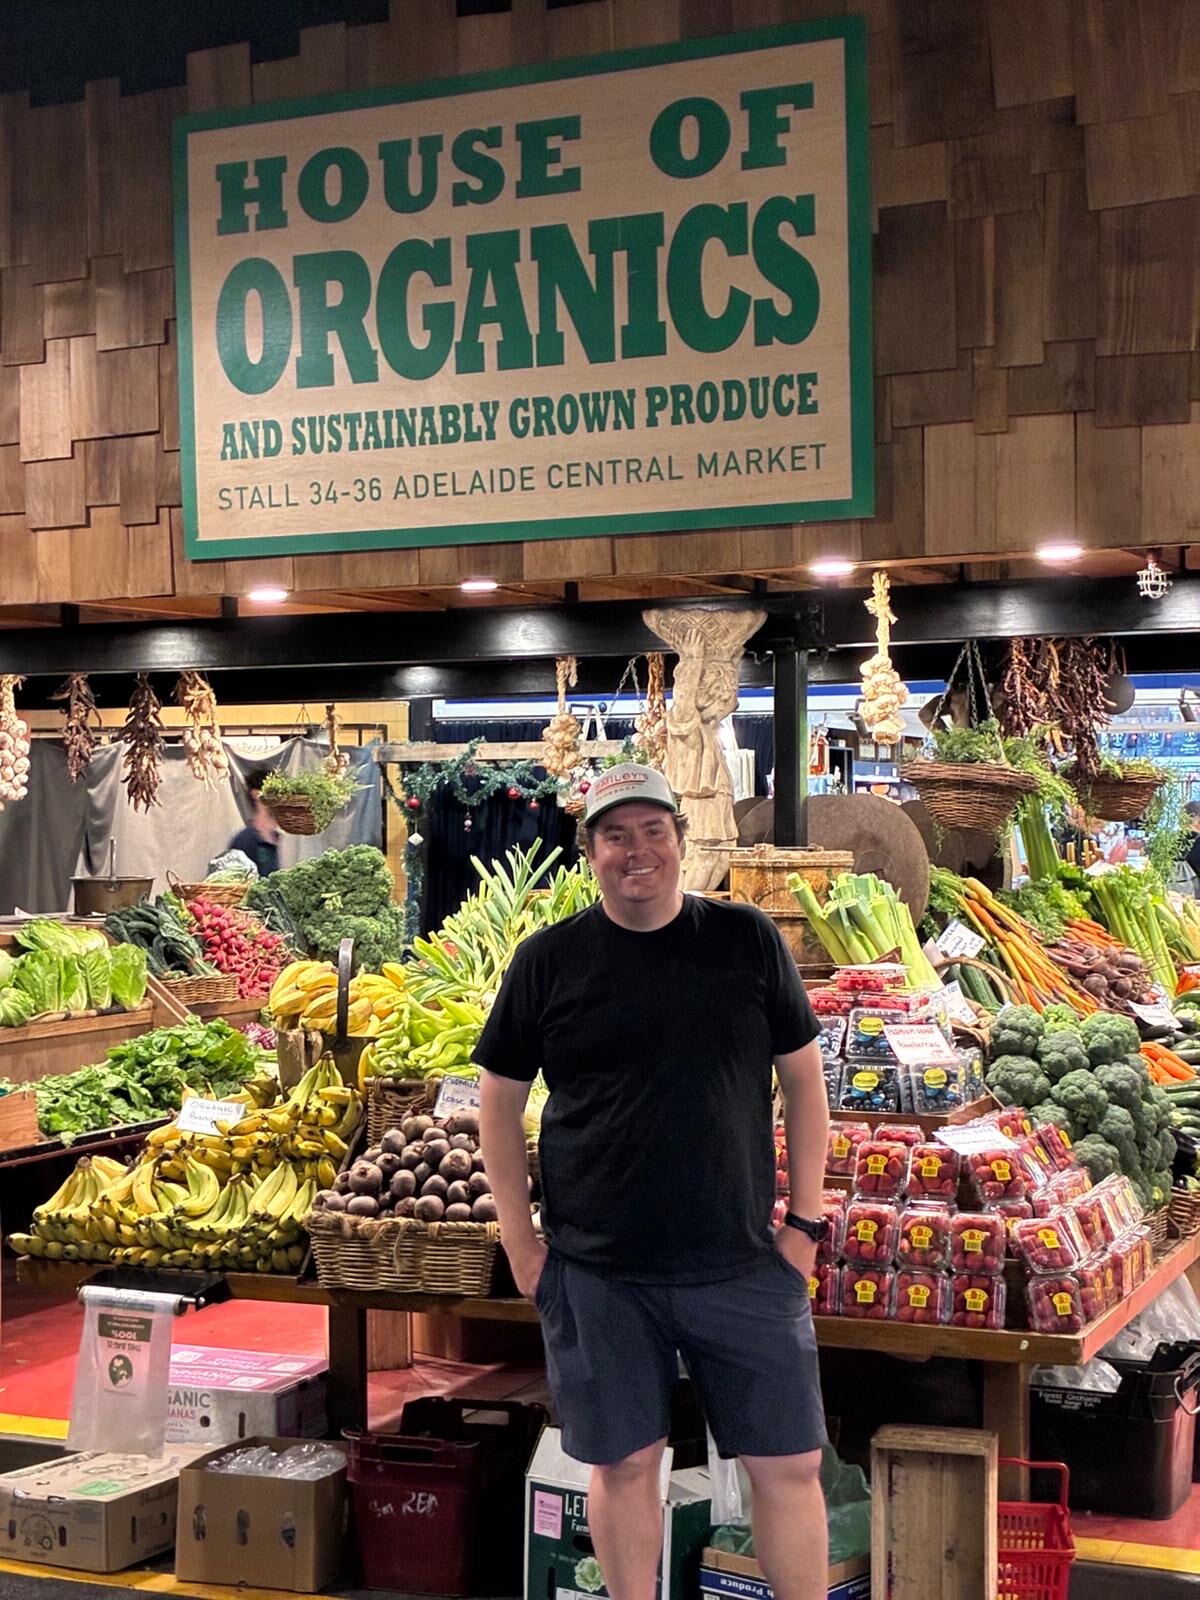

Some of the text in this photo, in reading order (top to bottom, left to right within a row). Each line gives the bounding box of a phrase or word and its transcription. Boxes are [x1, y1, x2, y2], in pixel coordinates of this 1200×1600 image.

[215, 80, 815, 235] HOUSE OF
[215, 193, 821, 395] ORGANICS
[220, 372, 820, 461] AND SUSTAINABLY GROWN PRODUCE
[218, 443, 827, 511] STALL 34-36 ADELAIDE CENTRAL MARKET
[112, 1329, 137, 1340] 100%
[168, 1389, 210, 1408] ANIC
[1039, 1391, 1063, 1400] Forest
[168, 1408, 197, 1420] ANAS
[564, 1493, 588, 1519] LET
[720, 1578, 764, 1597] Produce
